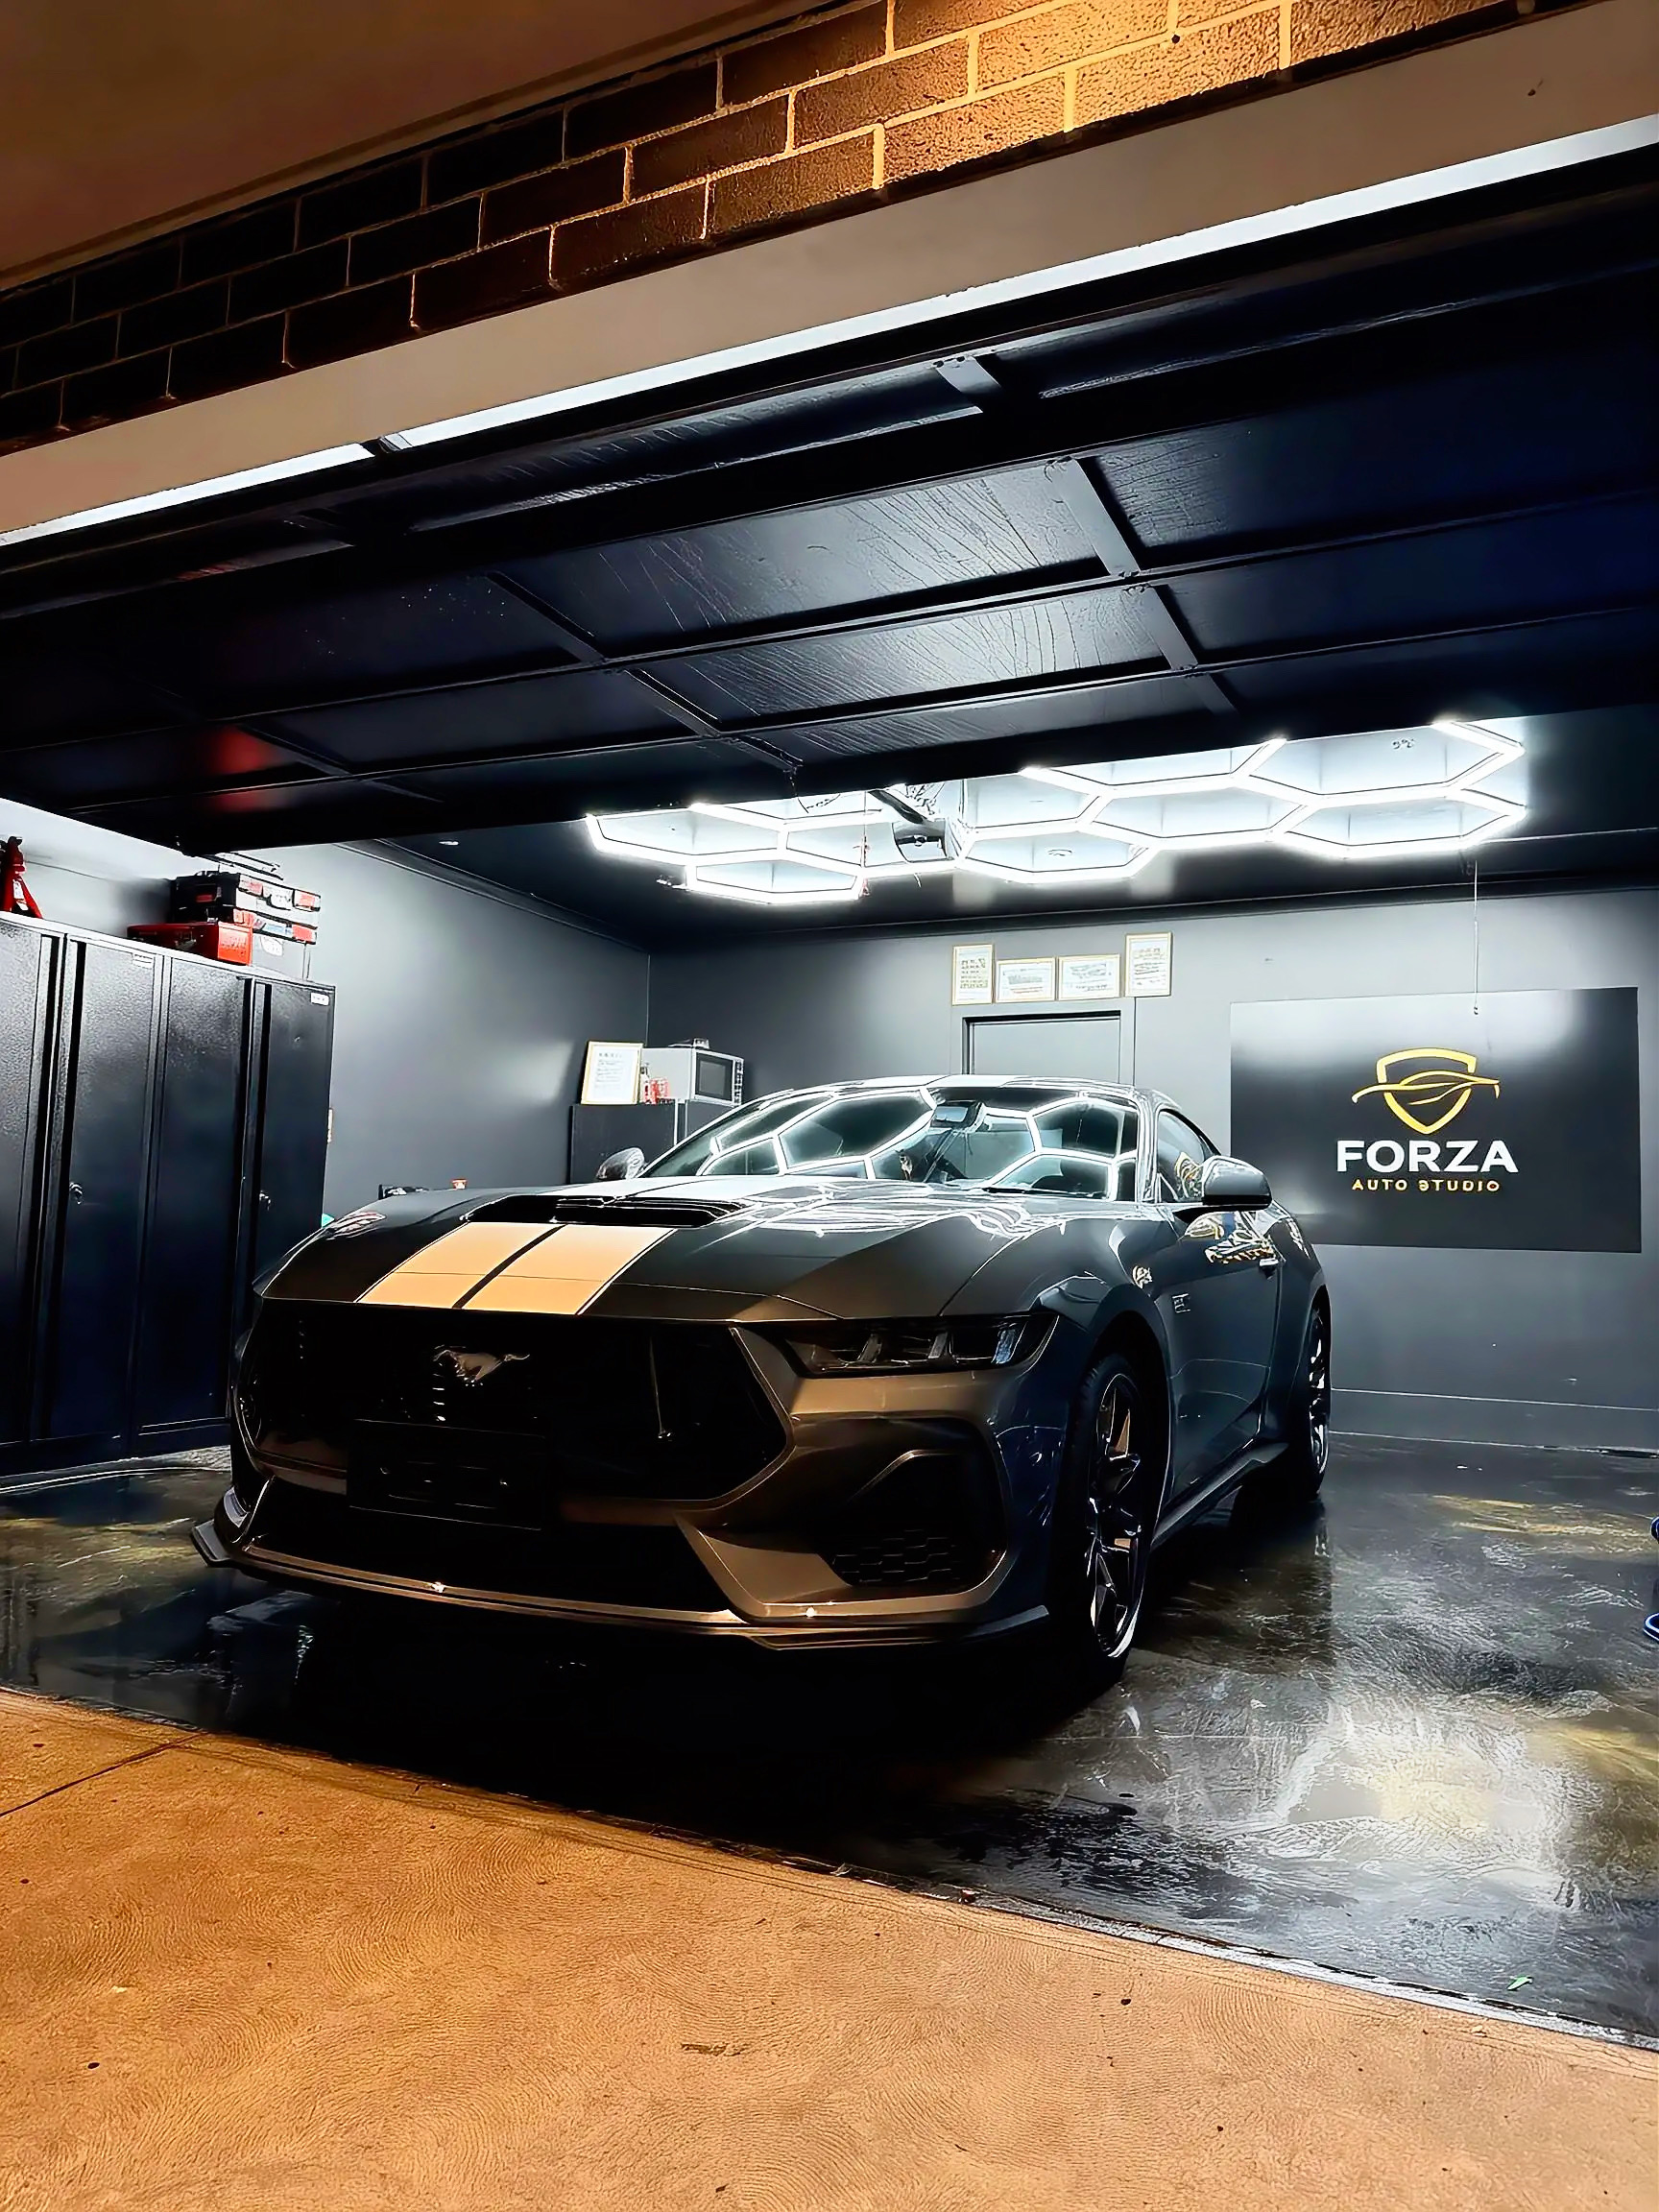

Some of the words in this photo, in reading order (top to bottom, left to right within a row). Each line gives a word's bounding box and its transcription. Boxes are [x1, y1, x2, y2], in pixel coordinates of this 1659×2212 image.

[1336, 1140, 1519, 1172] FORZA
[1351, 1178, 1408, 1191] AUTO
[1418, 1178, 1500, 1192] STUDIO
